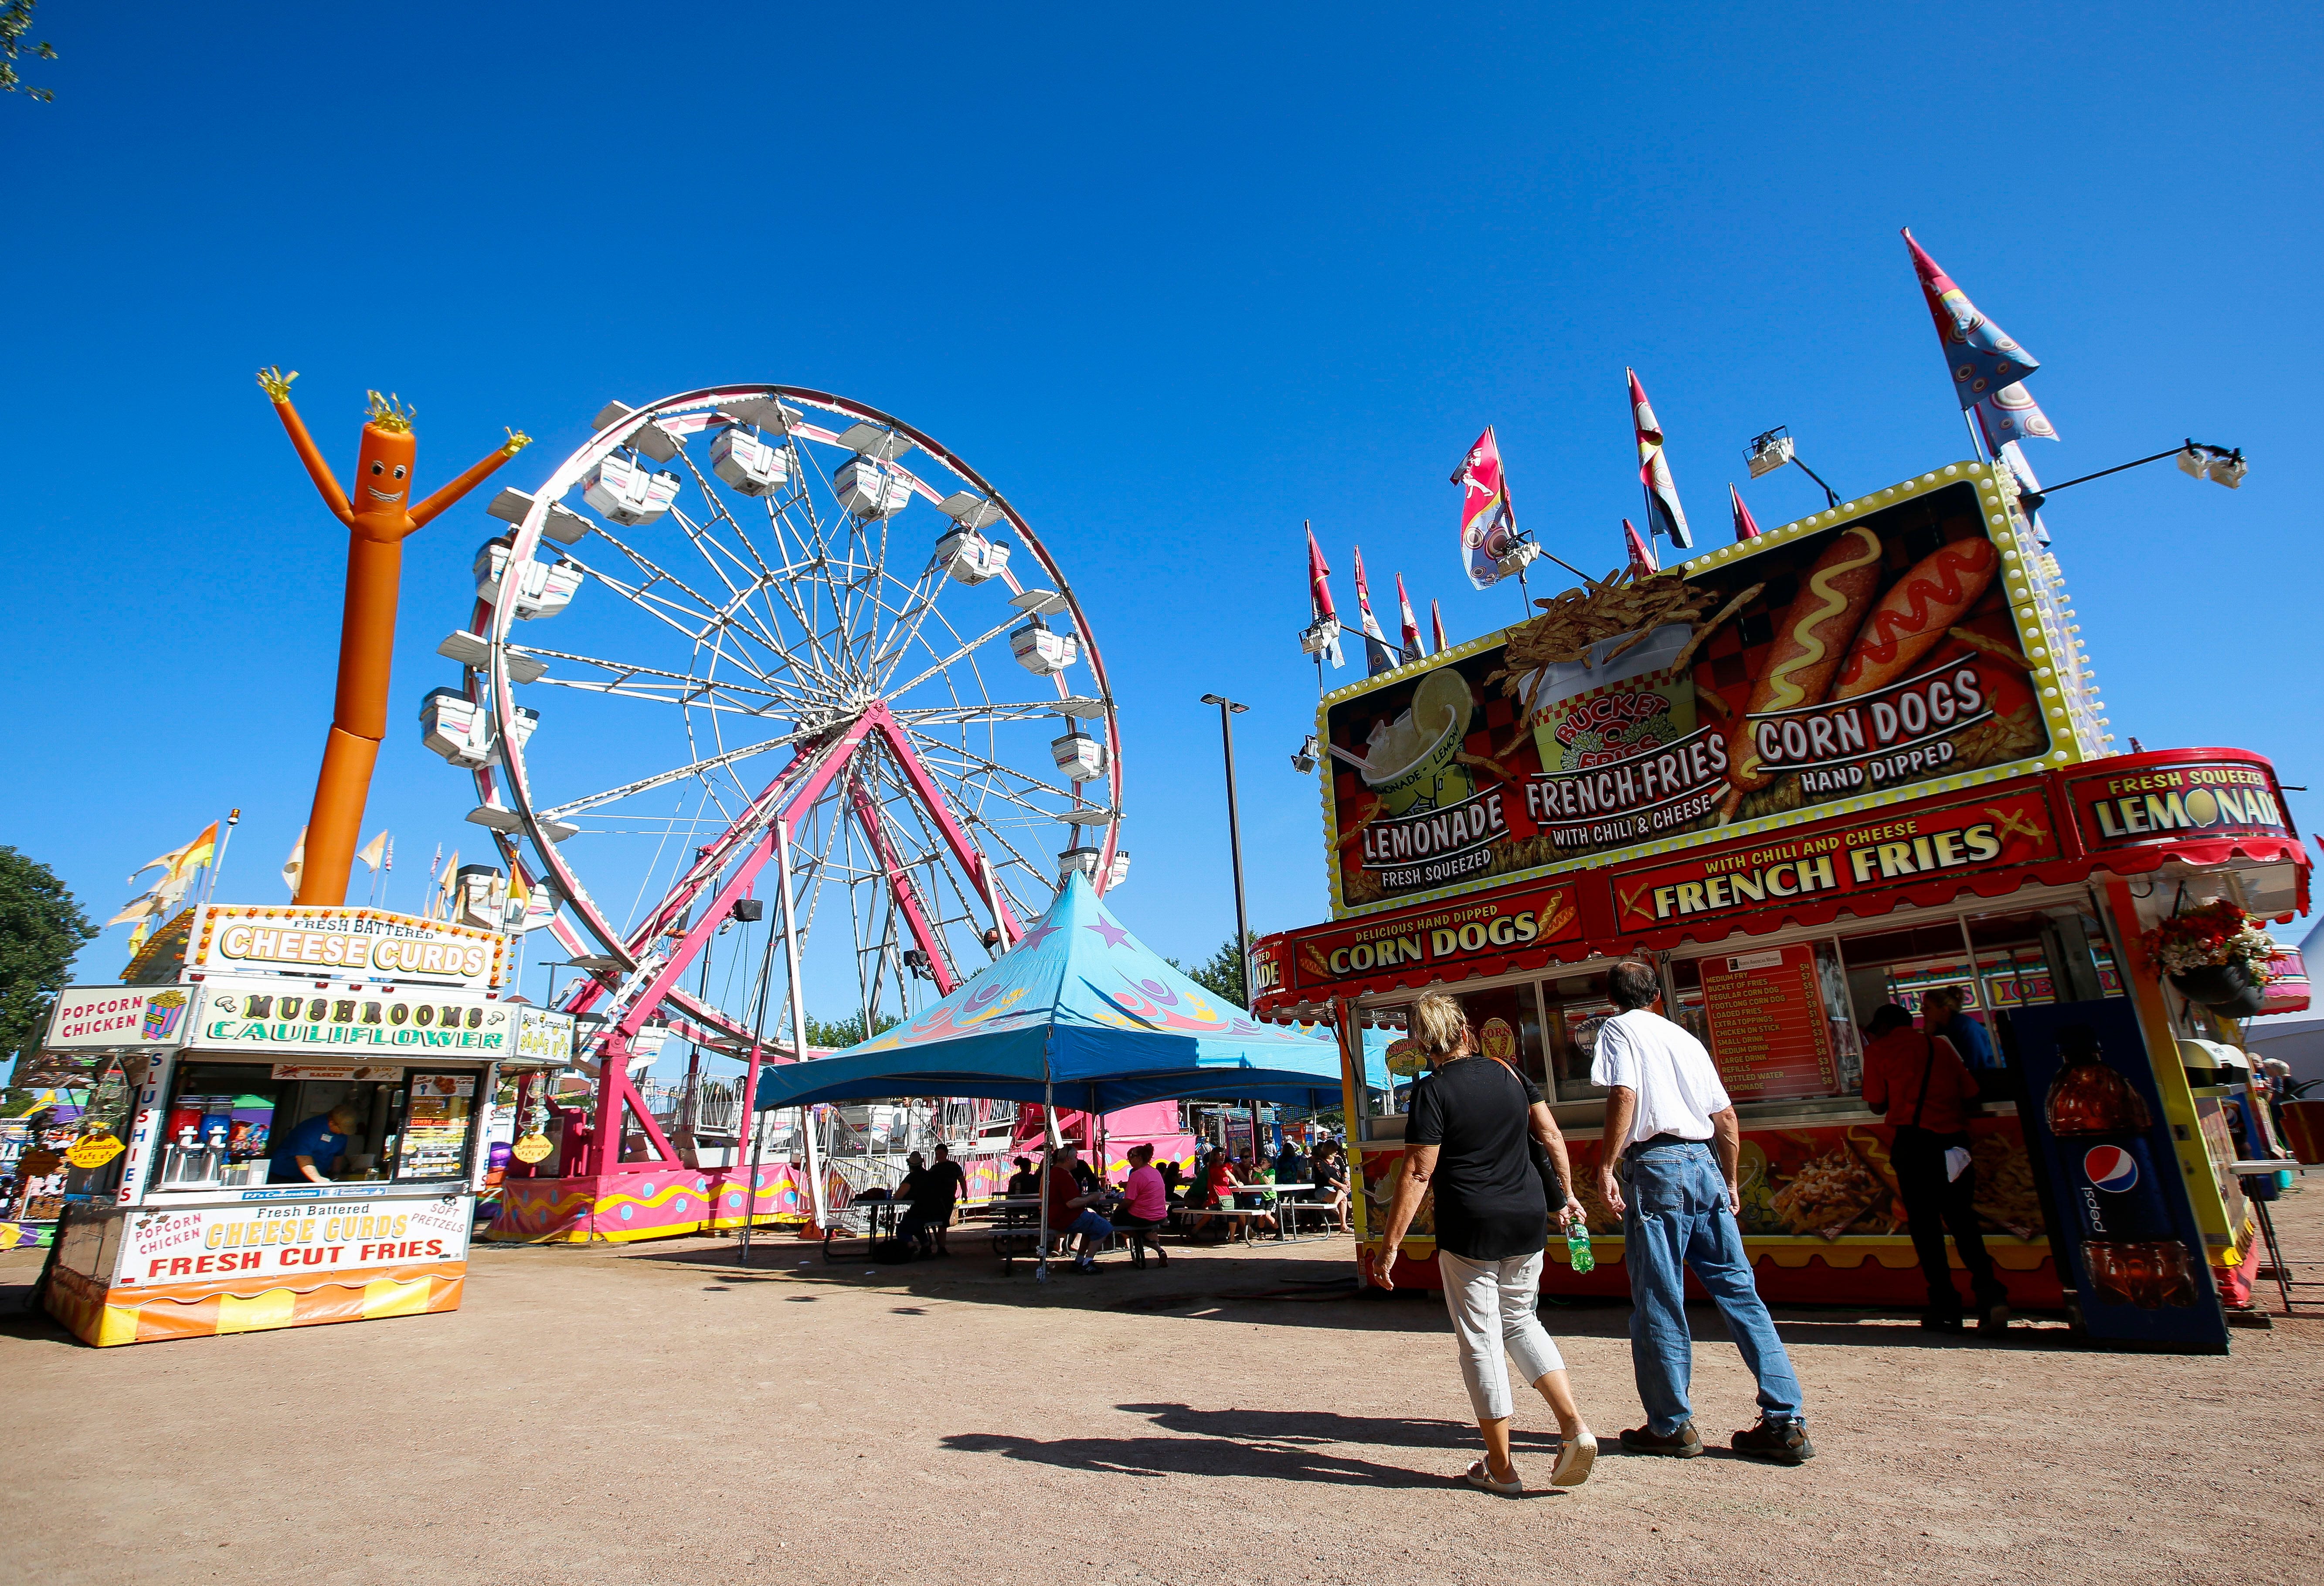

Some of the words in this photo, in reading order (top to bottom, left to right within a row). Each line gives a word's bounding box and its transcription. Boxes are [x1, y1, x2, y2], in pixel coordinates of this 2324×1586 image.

[1555, 692, 1670, 746] BUCKET
[1756, 707, 1866, 763] CORN
[1869, 669, 1983, 745] DOGS
[1525, 764, 1639, 820] FRENCH
[1641, 732, 1730, 792] FRIES
[1801, 766, 1864, 793] HAND
[1869, 740, 1955, 783] DIPPED
[2109, 772, 2184, 795] FRESH
[2188, 769, 2265, 786] SQUEEZED
[1362, 794, 1506, 862] LEMONADE
[1552, 825, 1590, 847] WITH
[1593, 817, 1633, 844] CHILI
[1636, 816, 1649, 835] &
[1653, 793, 1712, 831] CHEESE
[1705, 855, 1746, 874] WITH
[1751, 845, 1798, 864] CHILI
[1803, 837, 1840, 856] AND
[1845, 820, 1919, 847] CHEESE
[1381, 861, 1422, 888] FRESH
[1425, 847, 1492, 883] SQUEEZED
[1654, 854, 1837, 920] FRENCH
[1849, 822, 2002, 884] FRIES
[293, 920, 348, 933] FRESH
[353, 919, 434, 939] BATTERED
[1356, 922, 1414, 943] DELICIOUS
[1417, 914, 1450, 930] HAND
[1453, 905, 1498, 924] DIPPED
[221, 925, 370, 968] CHEESE
[373, 938, 486, 977] CURDS
[1329, 934, 1423, 975] CORN
[1432, 911, 1539, 958] DOGS
[1706, 974, 1733, 983] MEDIUM
[1733, 972, 1748, 980] FRY
[1800, 963, 1810, 971] $4
[1708, 983, 1735, 993] BUCKET
[1747, 979, 1768, 988] FRIES
[1709, 991, 1741, 1001] REGULAR
[1743, 989, 1762, 997] CORN
[1764, 987, 1779, 995] DOG
[1803, 982, 1814, 990] $5
[1711, 1000, 1748, 1010] FOOTLONG
[1749, 997, 1768, 1006] CORN
[1770, 995, 1785, 1003] DOG
[1805, 991, 1815, 1000] $7
[61, 995, 145, 1021] POPCORN
[242, 994, 483, 1029] MUSHROOMS
[1712, 1009, 1740, 1019] LOADED
[1742, 1007, 1762, 1016] FRIES
[1807, 1001, 1818, 1009] $9
[1714, 1019, 1736, 1028] EXTRA
[1737, 1015, 1773, 1026] TOPPINGS
[1809, 1010, 1818, 1018] $1
[62, 1014, 138, 1038] CHICKEN
[206, 1020, 503, 1049] CAULIFLOWER
[523, 1014, 538, 1026] Real
[540, 1015, 571, 1031] Lemonade
[1480, 1025, 1512, 1039] CORN
[1716, 1028, 1746, 1038] CHICKEN
[1759, 1023, 1780, 1032] STICK
[520, 1031, 548, 1055] SHAKE
[552, 1033, 569, 1058] UPS
[1717, 1037, 1741, 1046] SMALL
[1742, 1035, 1764, 1044] DRINK
[1719, 1046, 1747, 1056] MEDIUM
[1748, 1044, 1770, 1053] DRINK
[1814, 1038, 1825, 1046] $4
[1720, 1055, 1744, 1065] LARGE
[1745, 1053, 1767, 1062] DRINK
[1722, 1065, 1751, 1074] REFILLS
[1818, 1057, 1829, 1065] $3
[1724, 1073, 1756, 1083] BOTTLED
[1757, 1071, 1784, 1081] WATER
[1820, 1067, 1831, 1075] $3
[1725, 1082, 1764, 1093] LEMONADE
[119, 1052, 163, 1201] SLUSHIES
[72, 1143, 118, 1153] Lemonade
[264, 1190, 318, 1198] Concessions
[257, 1206, 301, 1218] Fresh
[307, 1204, 370, 1216] Battered
[411, 1212, 465, 1234] PRETZELS
[430, 1203, 460, 1219] SOFT
[2084, 1187, 2107, 1233] pepsi
[134, 1212, 203, 1242] POPCORN
[205, 1218, 318, 1250] CHEESE
[323, 1214, 408, 1243] CURDS
[139, 1227, 201, 1256] CHICKEN
[148, 1251, 261, 1278] FRESH
[279, 1246, 346, 1268] CUT
[359, 1239, 444, 1262] FRIES
